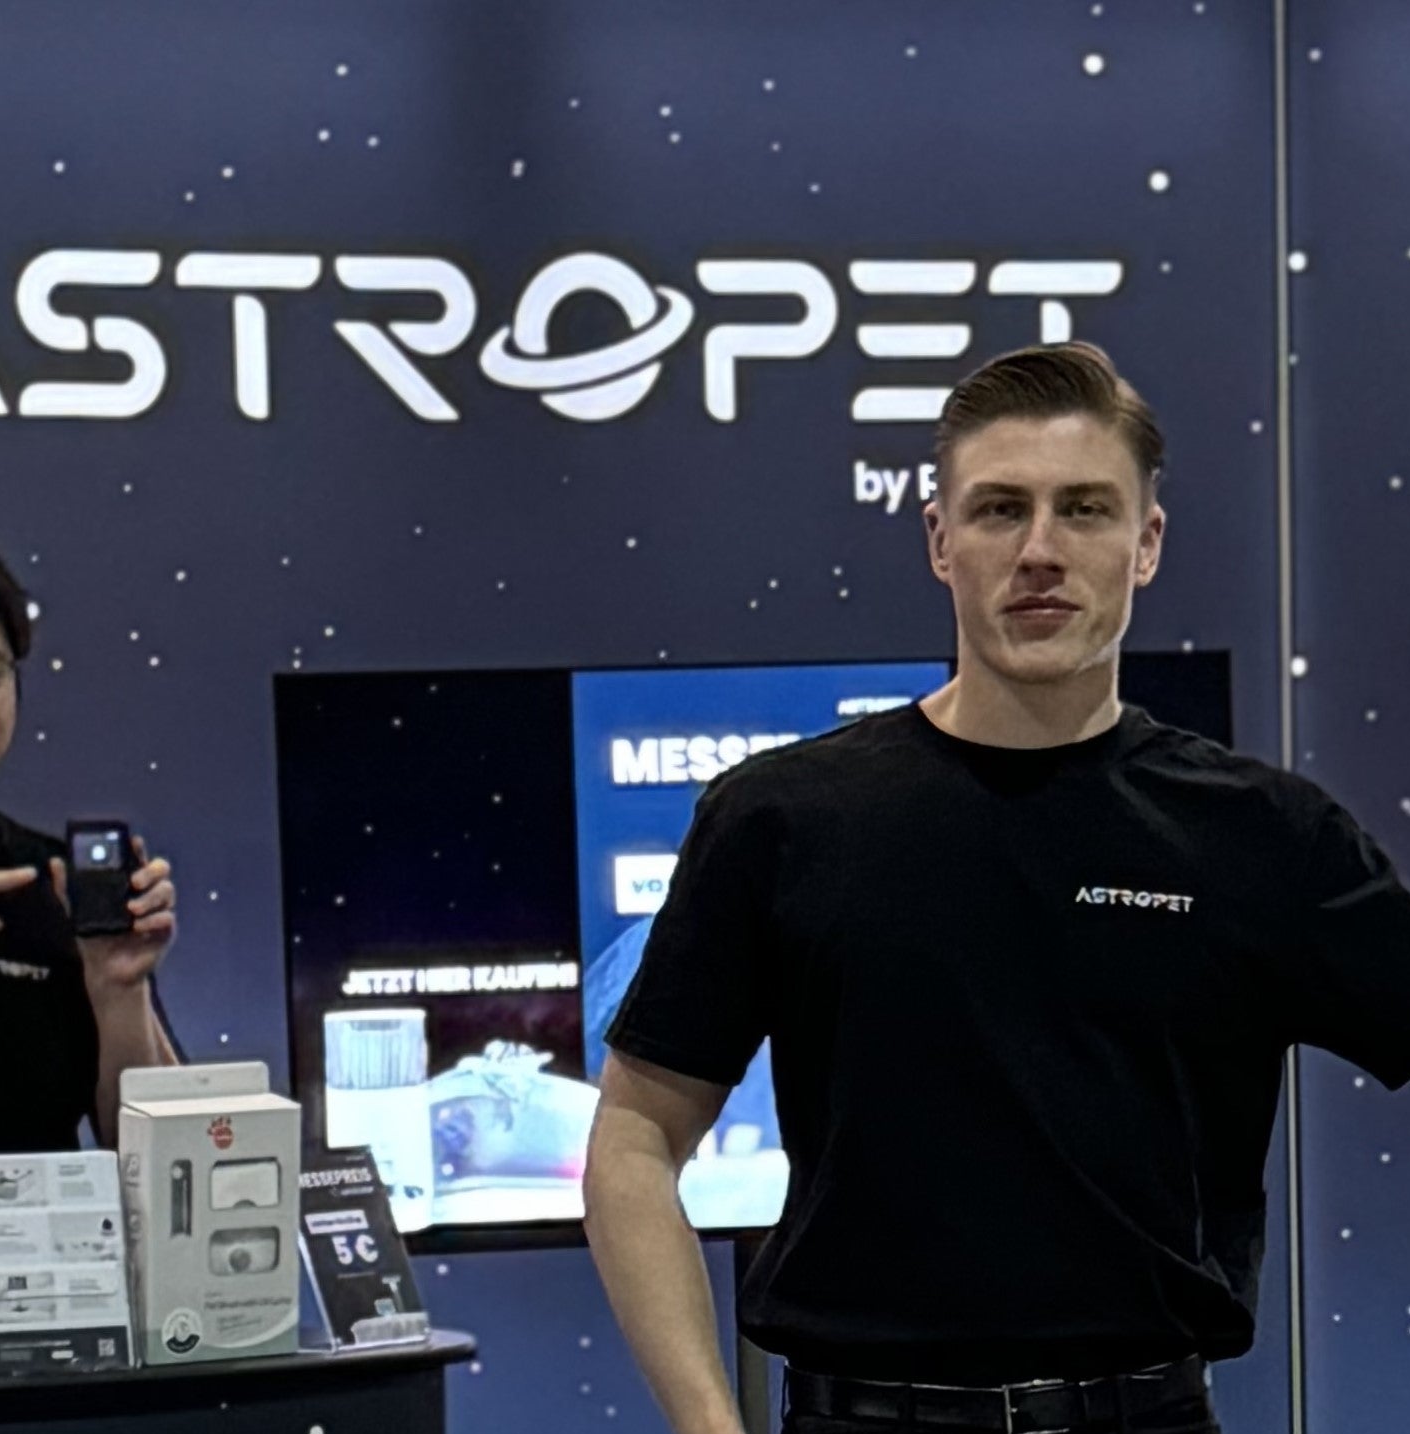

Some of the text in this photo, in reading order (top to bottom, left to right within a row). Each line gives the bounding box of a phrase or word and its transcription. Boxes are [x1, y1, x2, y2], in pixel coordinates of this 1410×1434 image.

[853, 460, 911, 514] by
[1075, 886, 1194, 913] ASTROPET
[299, 1167, 372, 1189] ESSEPREIS
[332, 1235, 353, 1265] 5
